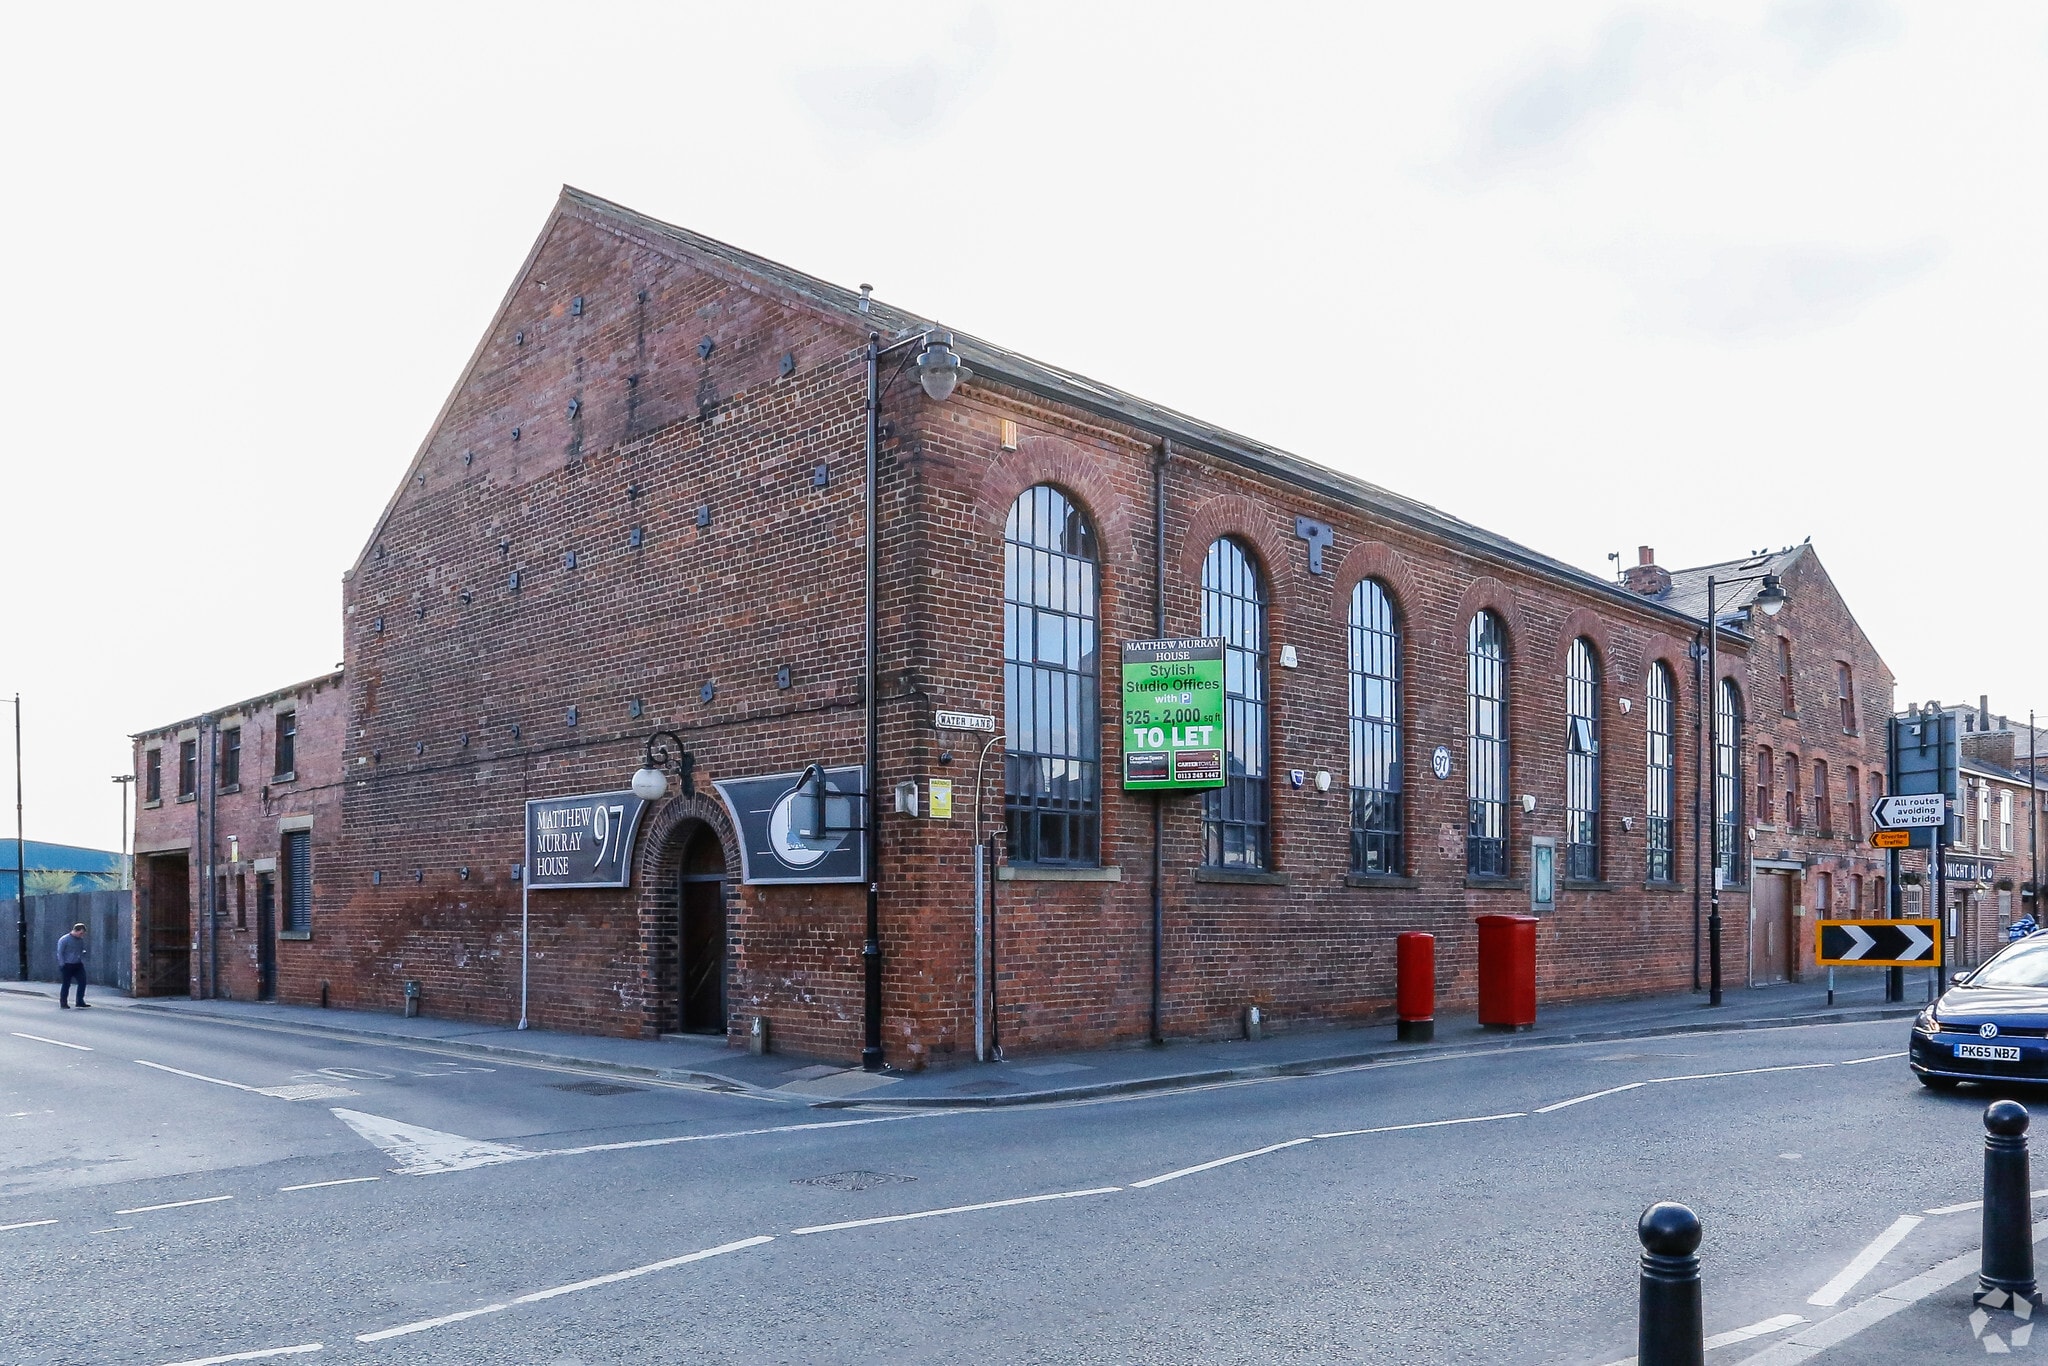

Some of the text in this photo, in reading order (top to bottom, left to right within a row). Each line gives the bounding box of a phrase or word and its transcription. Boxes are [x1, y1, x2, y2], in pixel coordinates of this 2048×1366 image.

[1126, 638, 1220, 651] MATTHEW MURRAY
[1156, 651, 1190, 661] HOUSE
[1150, 664, 1195, 678] Stylish
[1126, 679, 1220, 693] Studio Offices
[1154, 693, 1178, 703] with
[940, 715, 991, 728] WATER LANE
[1126, 710, 1151, 725] 525
[1163, 708, 1200, 726] 2,000
[1203, 714, 1213, 723] sq
[1215, 712, 1221, 720] ft
[1133, 725, 1213, 748] TO LET
[1435, 755, 1447, 772] 97
[1894, 798, 1940, 807] All routes
[1897, 807, 1936, 815] avoiding
[1911, 815, 1941, 824] bridge
[536, 832, 583, 853] MURRAY
[537, 805, 624, 867] MATTHEW 97
[536, 857, 569, 876] HOUSE
[1961, 1046, 2018, 1060] PK65 NBZ
